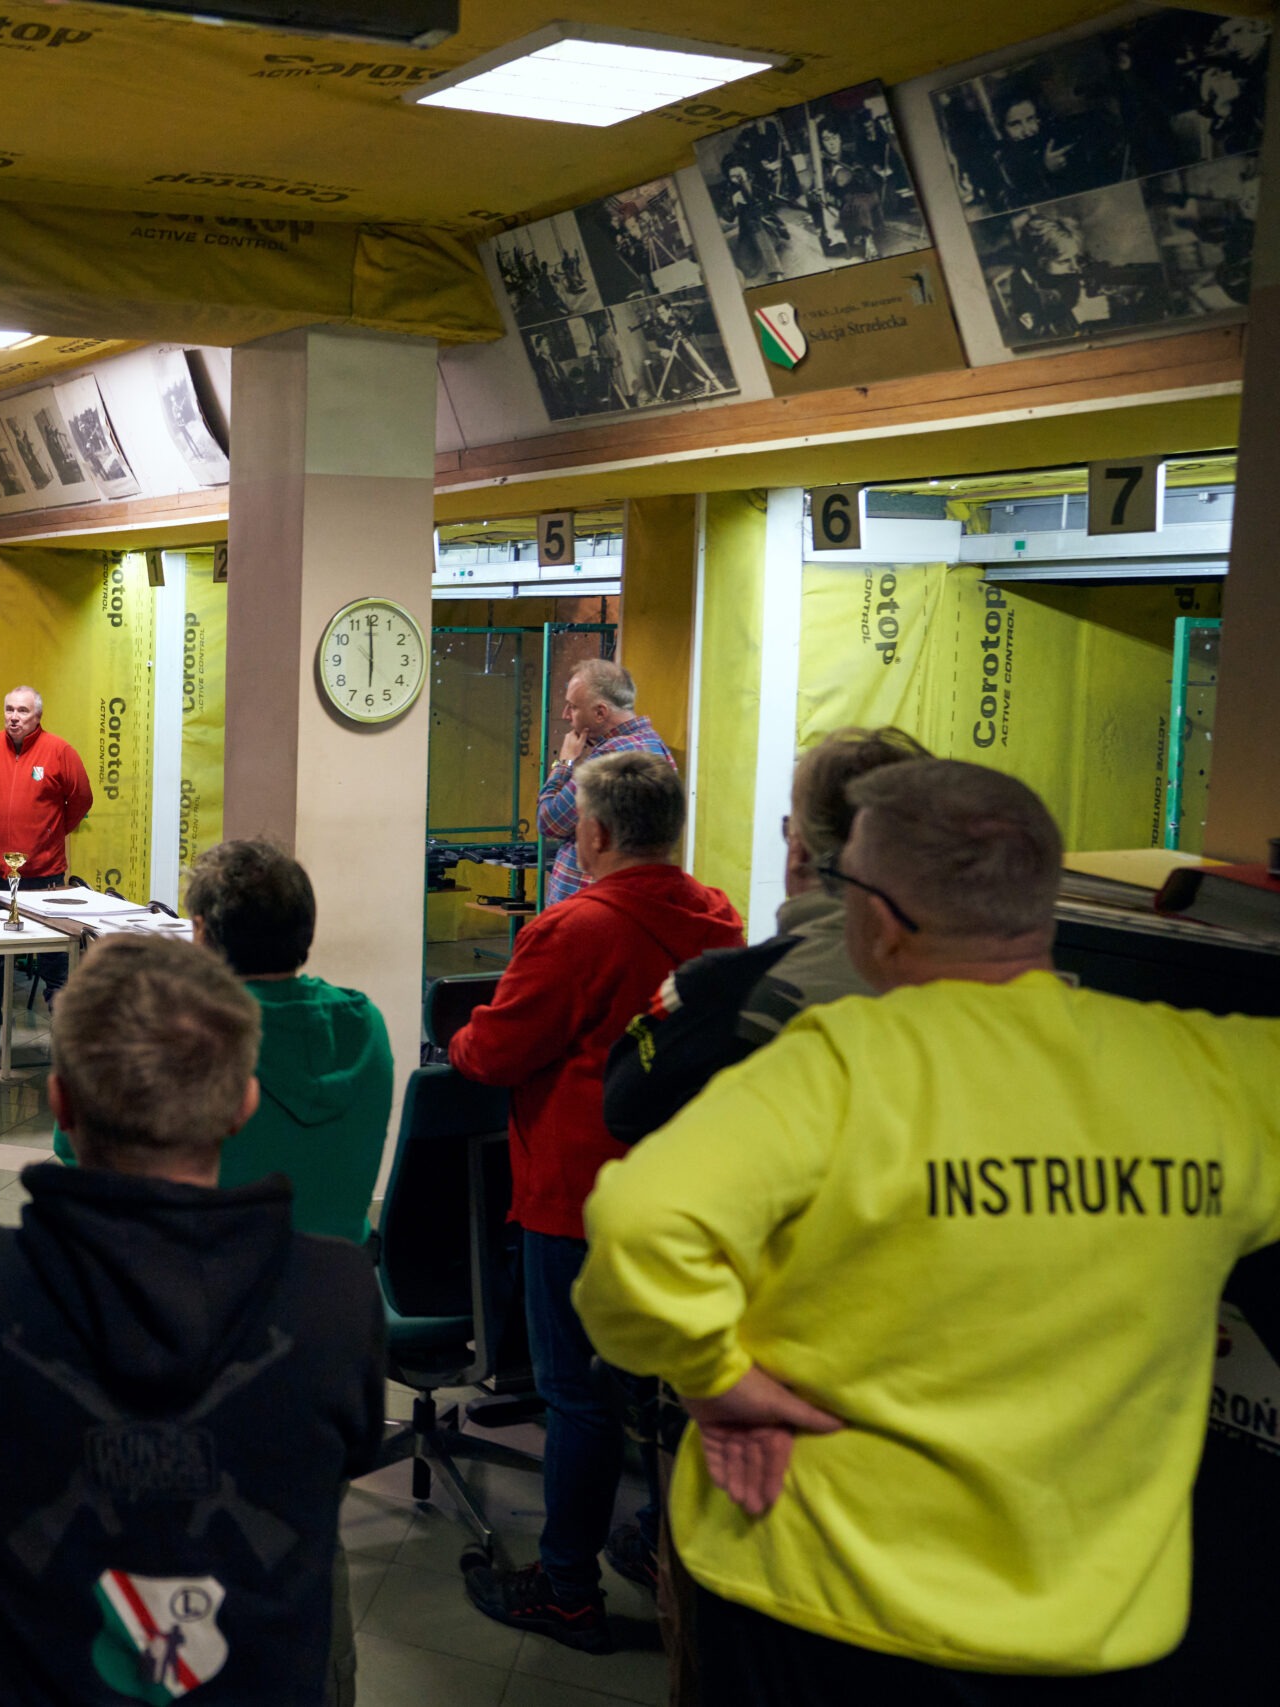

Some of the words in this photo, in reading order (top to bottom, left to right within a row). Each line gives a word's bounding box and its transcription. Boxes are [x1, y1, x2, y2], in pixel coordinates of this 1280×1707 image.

[263, 53, 456, 80] Corot
[146, 173, 351, 204] Corotop
[130, 226, 197, 244] ACTIVE
[204, 233, 290, 253] CONTROL
[1104, 465, 1144, 526] 7
[821, 493, 852, 544] 6
[543, 520, 565, 561] 5
[150, 555, 160, 582] 1
[218, 547, 228, 579] 2
[102, 563, 110, 613] CONTROL
[366, 614, 379, 627] 12
[861, 568, 874, 645] CONTROL
[875, 572, 902, 667] otop
[335, 633, 350, 646] 10
[350, 619, 360, 632] 11
[387, 619, 392, 632] 1
[396, 633, 406, 646] 2
[332, 654, 342, 667] 9
[400, 654, 409, 667] 3
[1004, 609, 1016, 684] CONTROL
[336, 674, 346, 687] 8
[394, 674, 404, 687] 4
[973, 585, 1008, 749] Corotop
[348, 689, 358, 702] 7
[365, 694, 375, 707] 6
[382, 689, 392, 702] 5
[99, 698, 107, 734] ACTIVE
[1001, 689, 1012, 747] ACTIVE
[103, 697, 127, 801] Corotop
[1156, 716, 1167, 772] ACTIVE
[98, 737, 107, 785] CONTROL
[1150, 776, 1163, 848] CONTROL
[927, 1157, 1222, 1217] INSTRUKTOR
